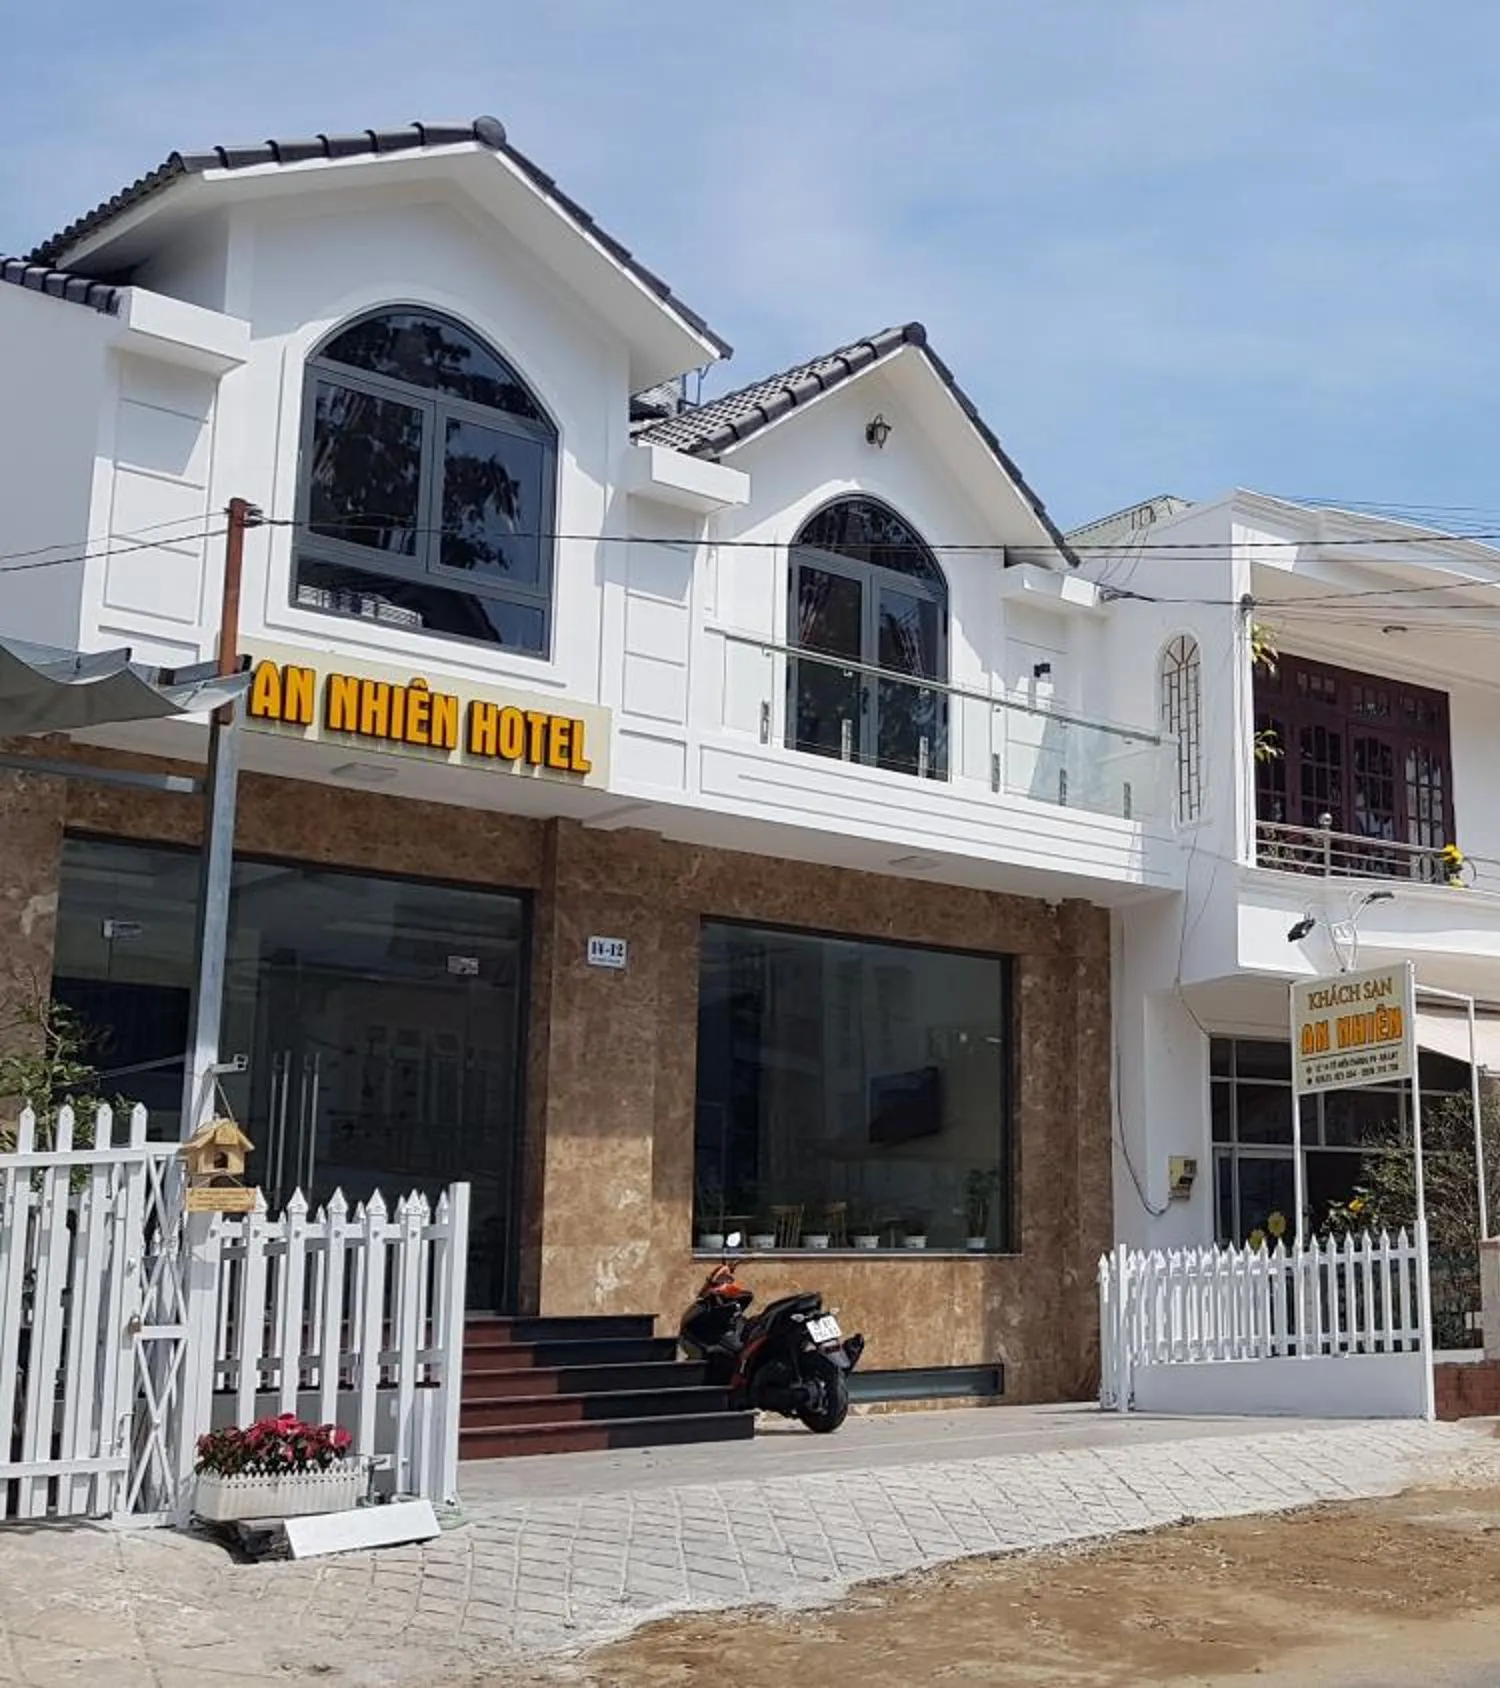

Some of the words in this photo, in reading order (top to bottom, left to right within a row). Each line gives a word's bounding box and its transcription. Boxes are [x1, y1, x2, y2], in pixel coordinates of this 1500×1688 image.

[250, 659, 315, 726] AN
[324, 673, 459, 751] NHIÊN
[467, 700, 592, 774] HOTEL
[1308, 984, 1361, 1010] KHÁCH
[1363, 977, 1392, 1000] SẠN
[1302, 1020, 1329, 1054] AN
[1336, 1003, 1402, 1048] NHIÊN
